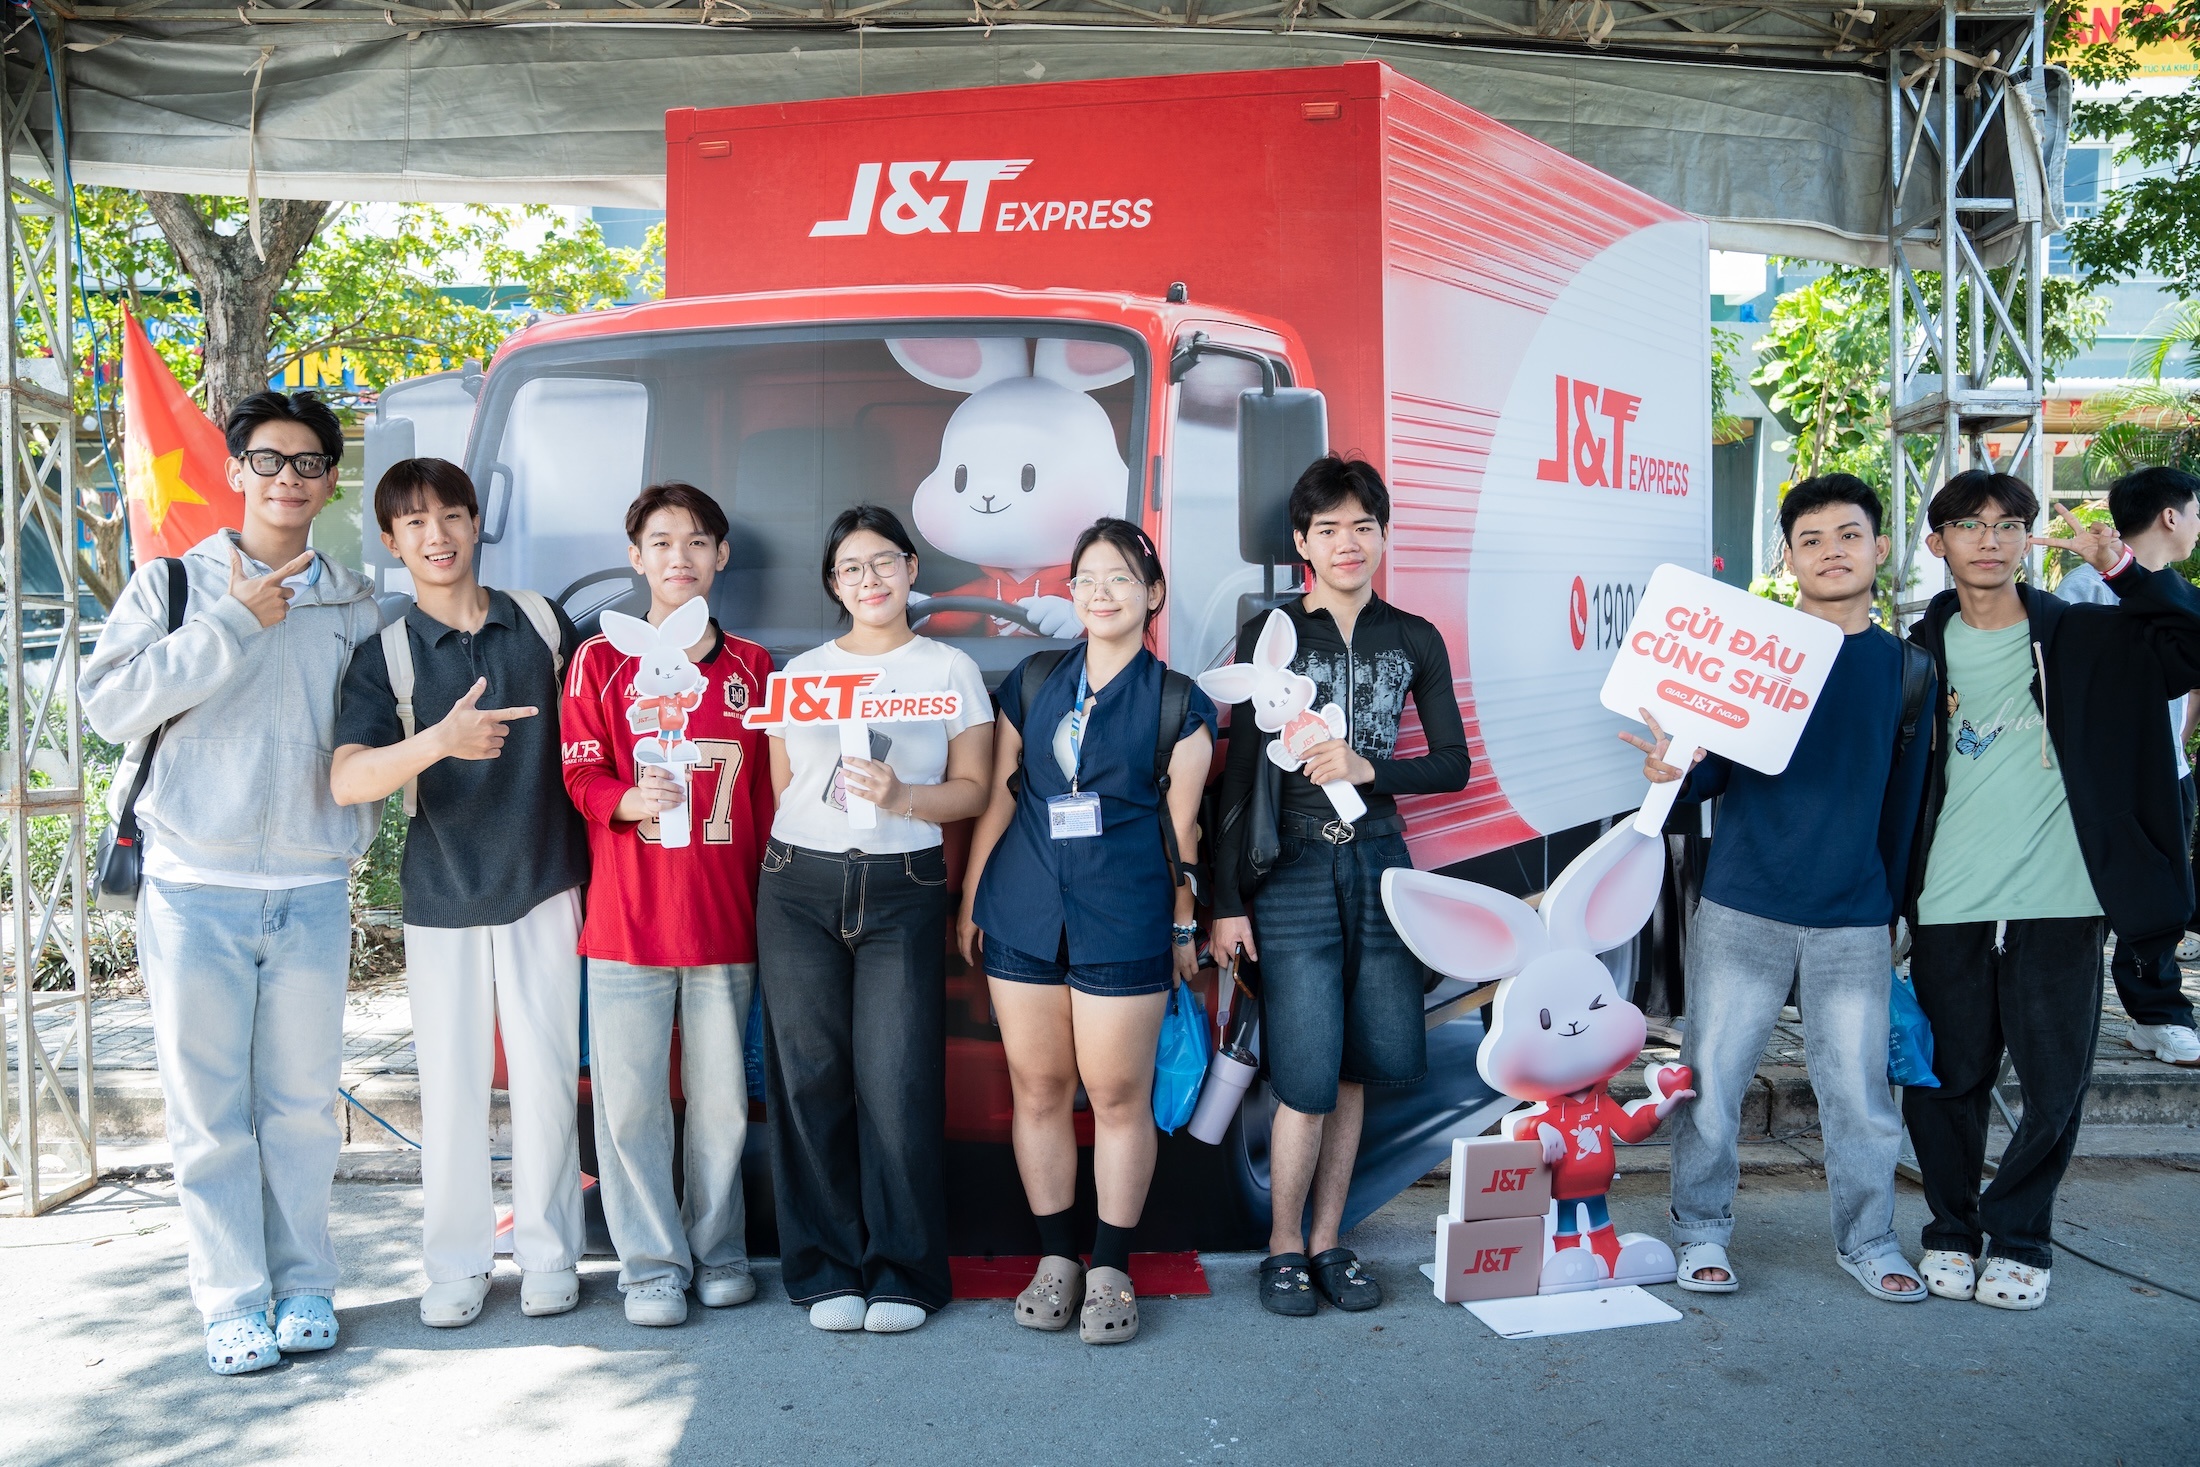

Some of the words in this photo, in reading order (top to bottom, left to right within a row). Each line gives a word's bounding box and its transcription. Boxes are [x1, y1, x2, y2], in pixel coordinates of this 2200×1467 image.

[808, 159, 1034, 237] J&T
[995, 198, 1153, 232] EXPRESS
[1537, 374, 1642, 489] J&T
[1629, 454, 1689, 497] EXPRESS
[1665, 606, 1724, 645] GỬI
[1728, 628, 1806, 675] ĐÂU
[748, 673, 880, 723] J&T
[861, 696, 957, 718] EXPRESS
[1631, 630, 1725, 683] CŨNG
[1728, 668, 1810, 713] SHIP
[1665, 687, 1688, 700] GIAO
[1683, 694, 1723, 714] J&T
[1716, 708, 1745, 723] NGAY
[1481, 1167, 1537, 1193] J&T
[1463, 1246, 1523, 1275] J&T
